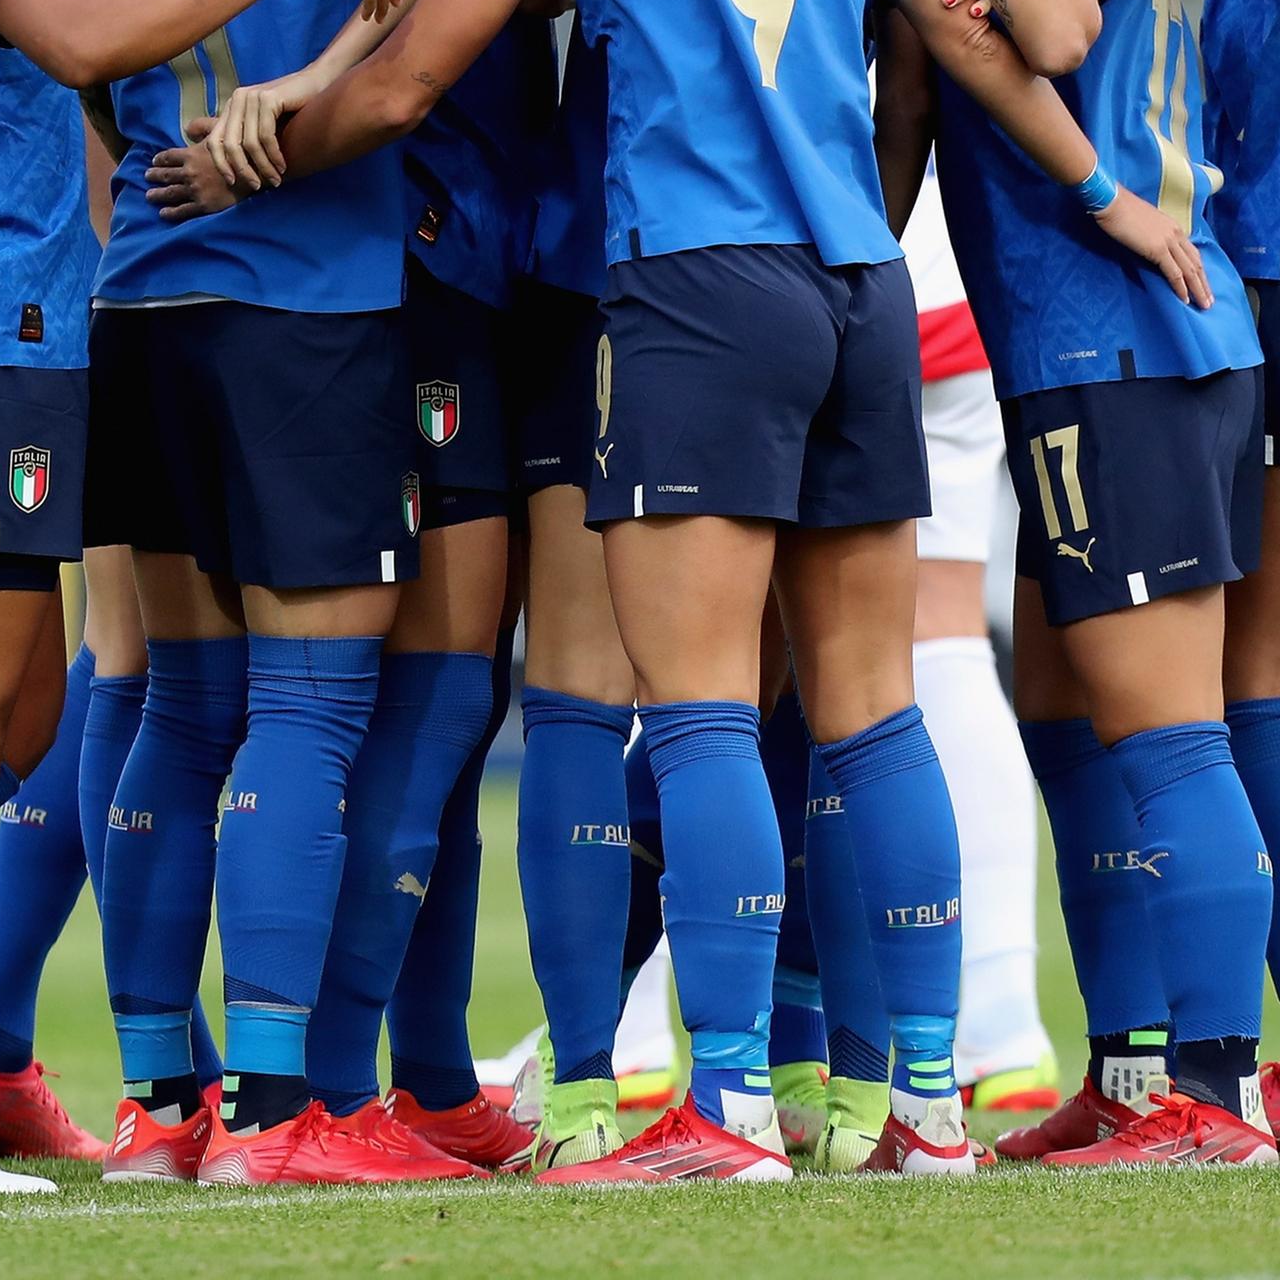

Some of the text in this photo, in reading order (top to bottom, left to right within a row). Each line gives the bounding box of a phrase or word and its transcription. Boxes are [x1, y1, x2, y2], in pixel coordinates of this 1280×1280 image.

[421, 387, 455, 398] ITALIA
[595, 333, 613, 439] 9
[14, 452, 46, 463] ITALIA
[1029, 424, 1089, 540] 17
[1, 802, 47, 824] ALIA
[108, 804, 153, 830] ALIA
[886, 897, 960, 925] ITALIA
